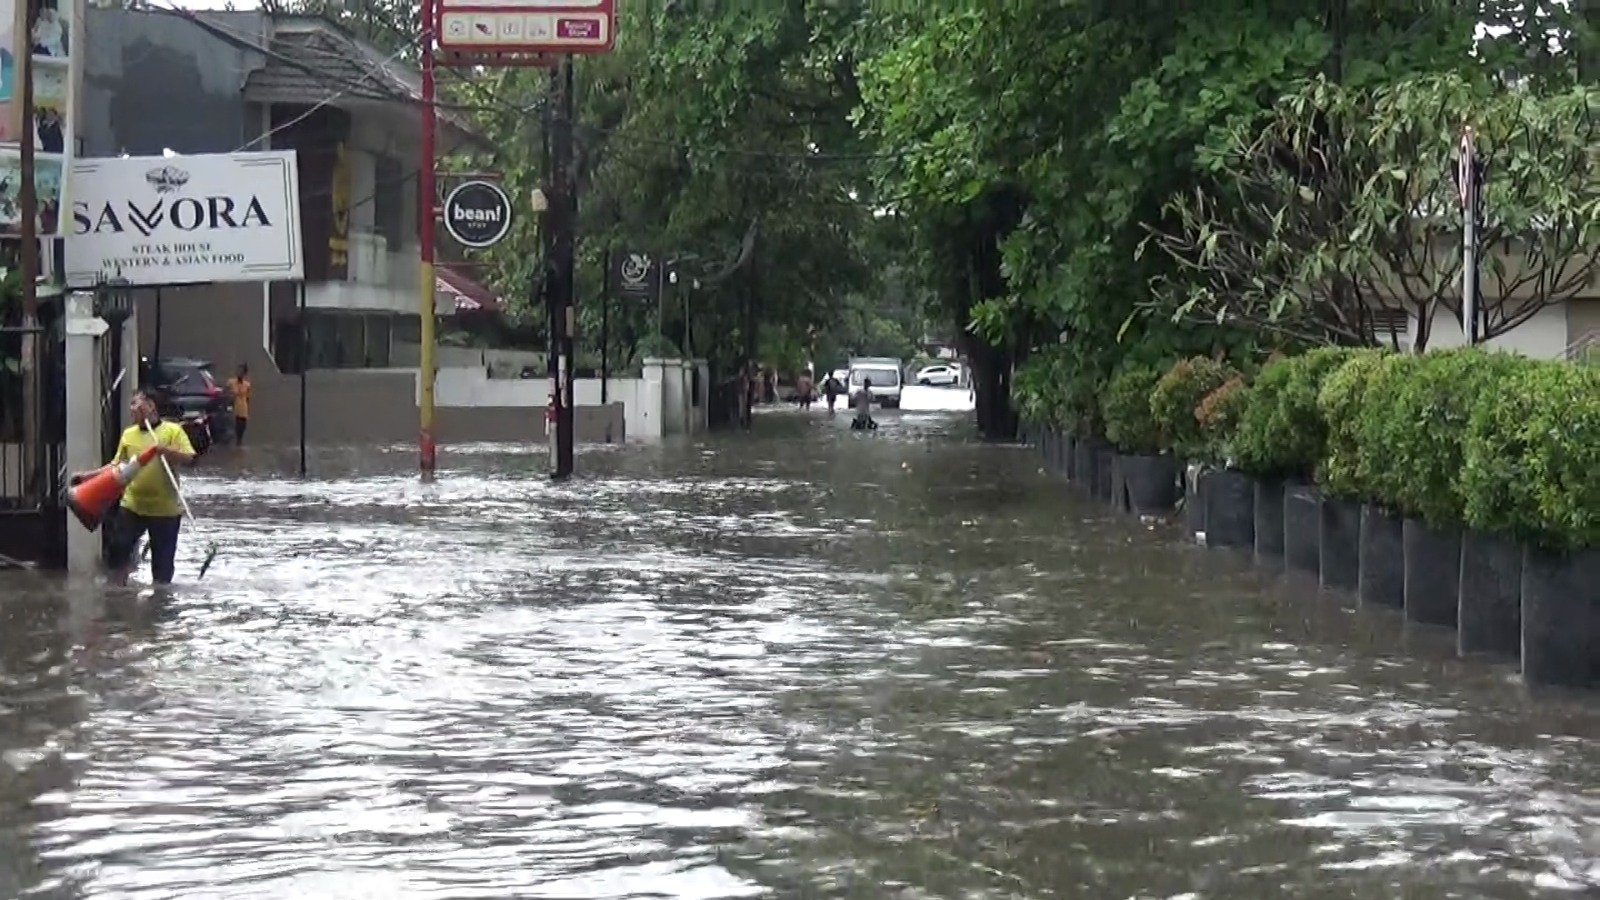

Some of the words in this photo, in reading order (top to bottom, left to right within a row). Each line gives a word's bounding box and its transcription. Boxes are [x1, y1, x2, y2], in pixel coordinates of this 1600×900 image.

[73, 194, 273, 237] SAVORA
[454, 203, 501, 222] bean!
[132, 243, 171, 255] STEAK
[173, 242, 212, 254] HOUSE
[102, 256, 159, 269] WESTERN
[161, 256, 171, 266] &
[175, 254, 210, 266] ASIAN
[211, 253, 245, 264] FOOD
